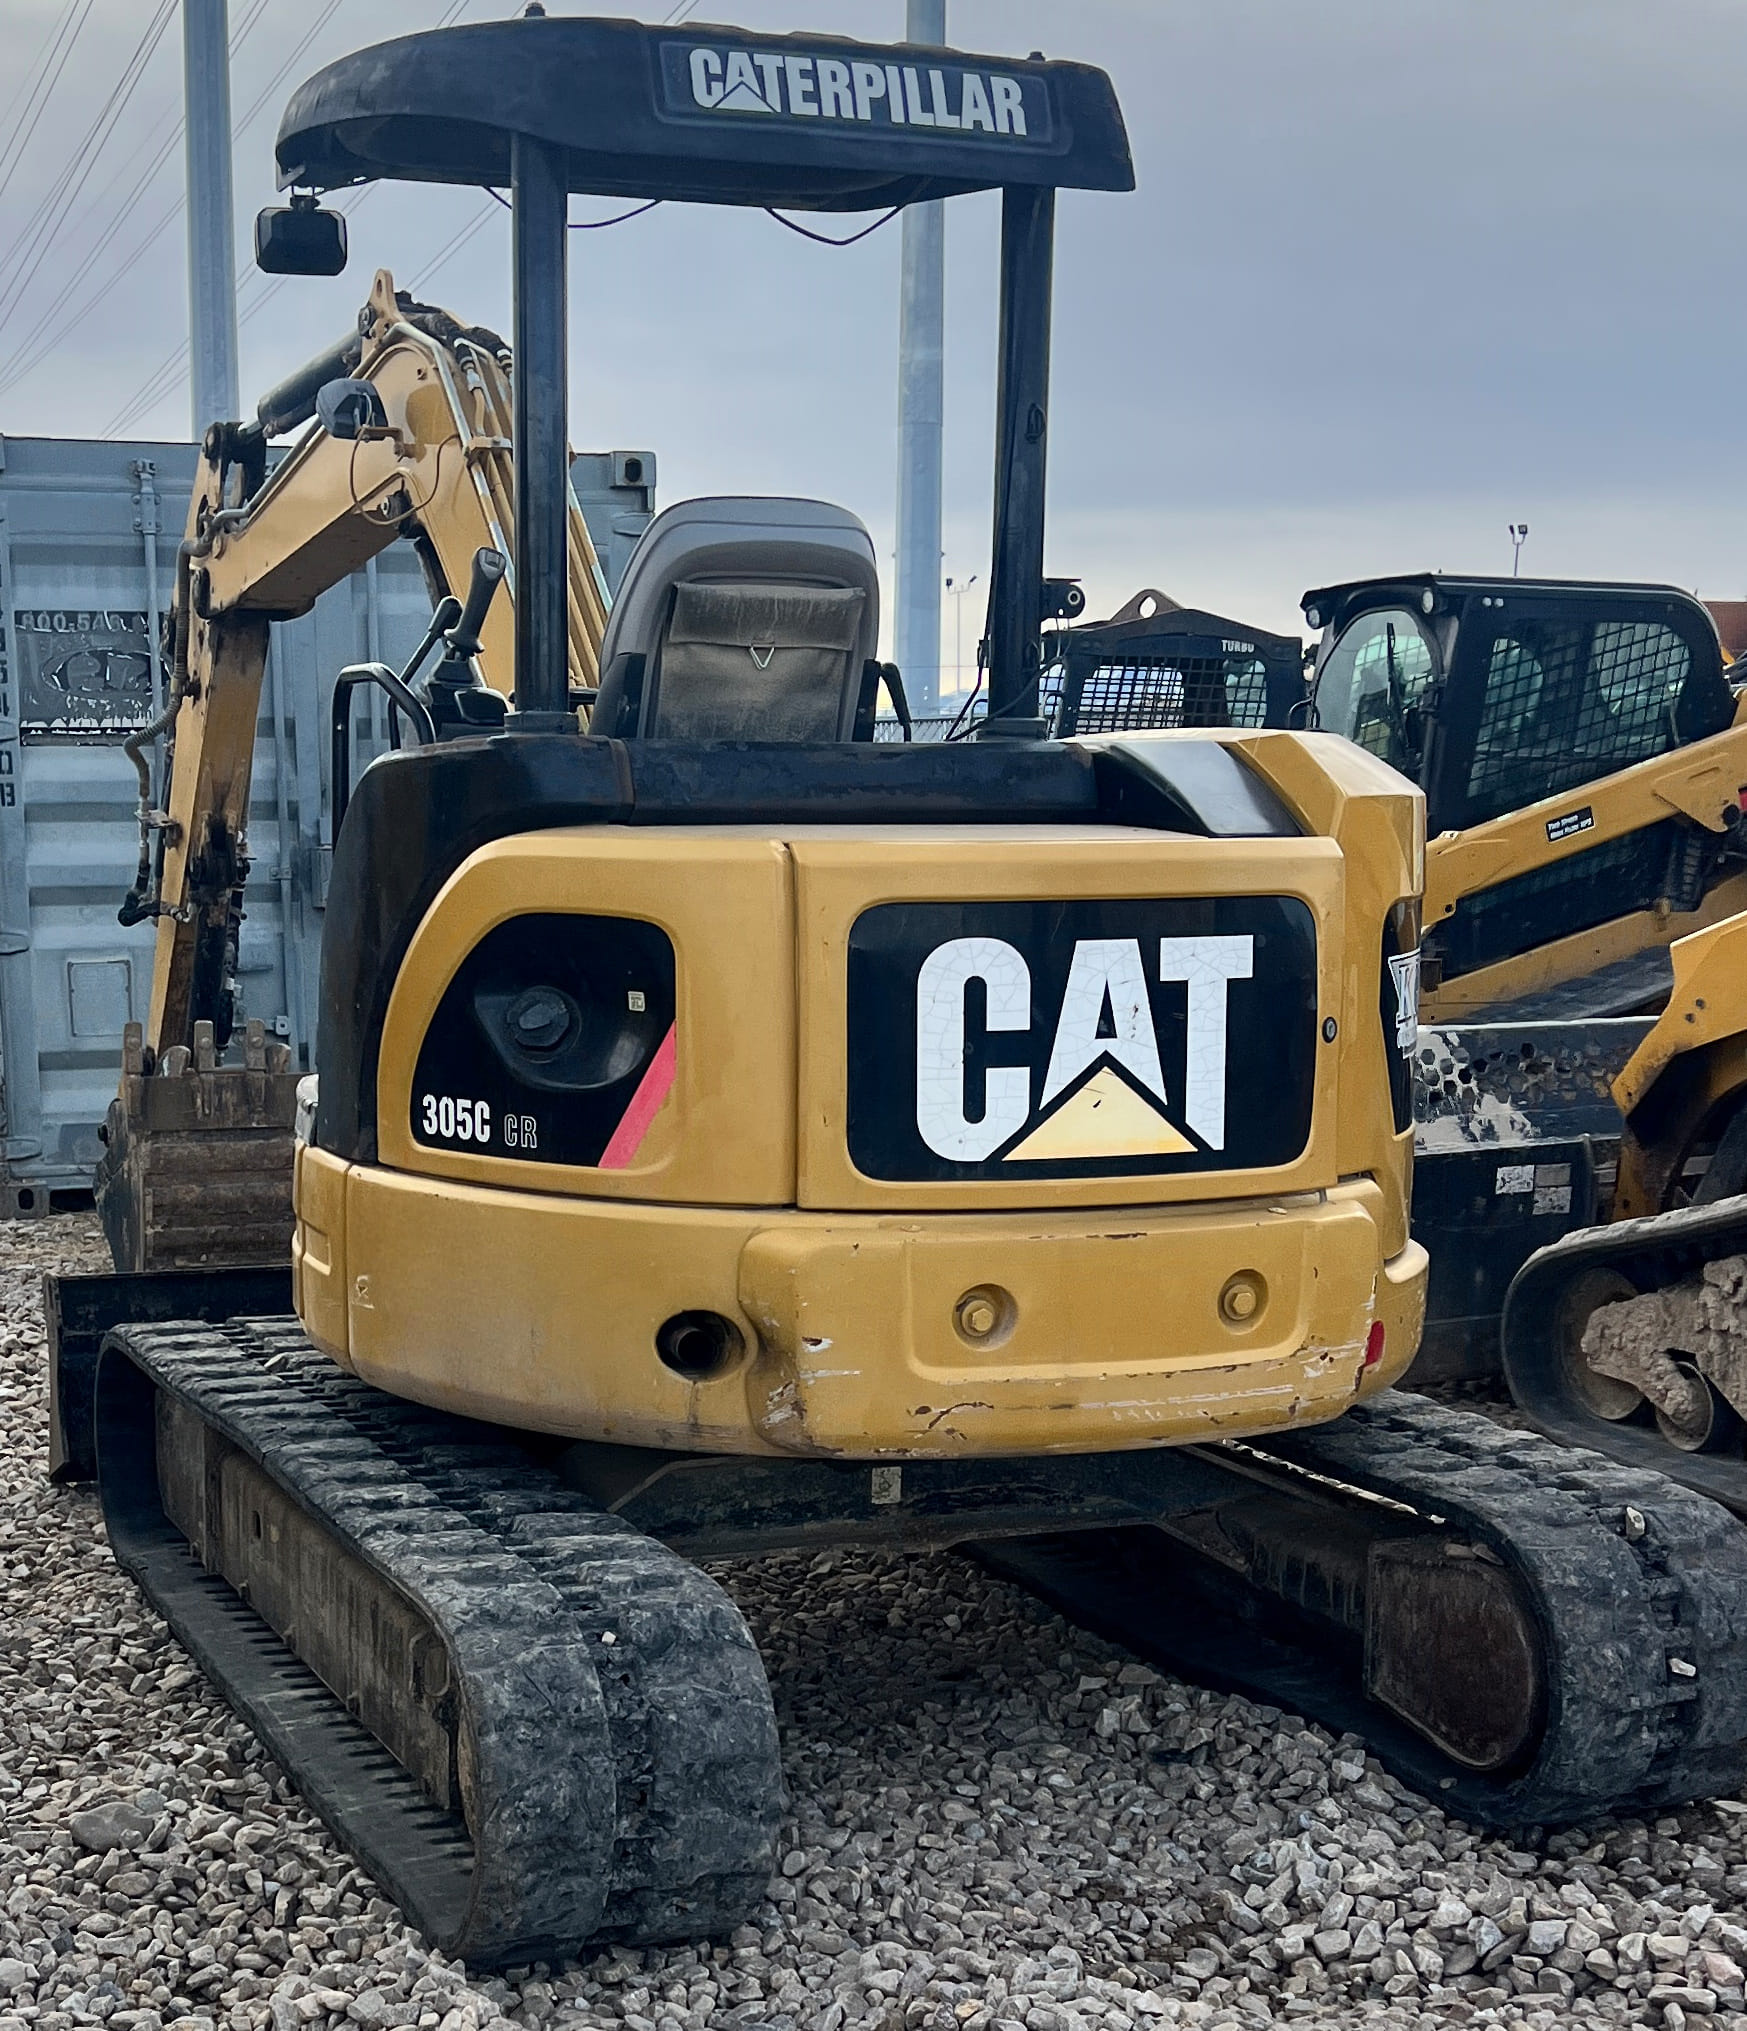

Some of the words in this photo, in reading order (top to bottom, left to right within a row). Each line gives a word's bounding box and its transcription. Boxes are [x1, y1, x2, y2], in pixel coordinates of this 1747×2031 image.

[689, 48, 1027, 136] CATERPILLAR
[1221, 639, 1255, 653] TURBO
[917, 935, 1254, 1162] CAT
[422, 1094, 490, 1143] 305C
[504, 1114, 538, 1149] CR
